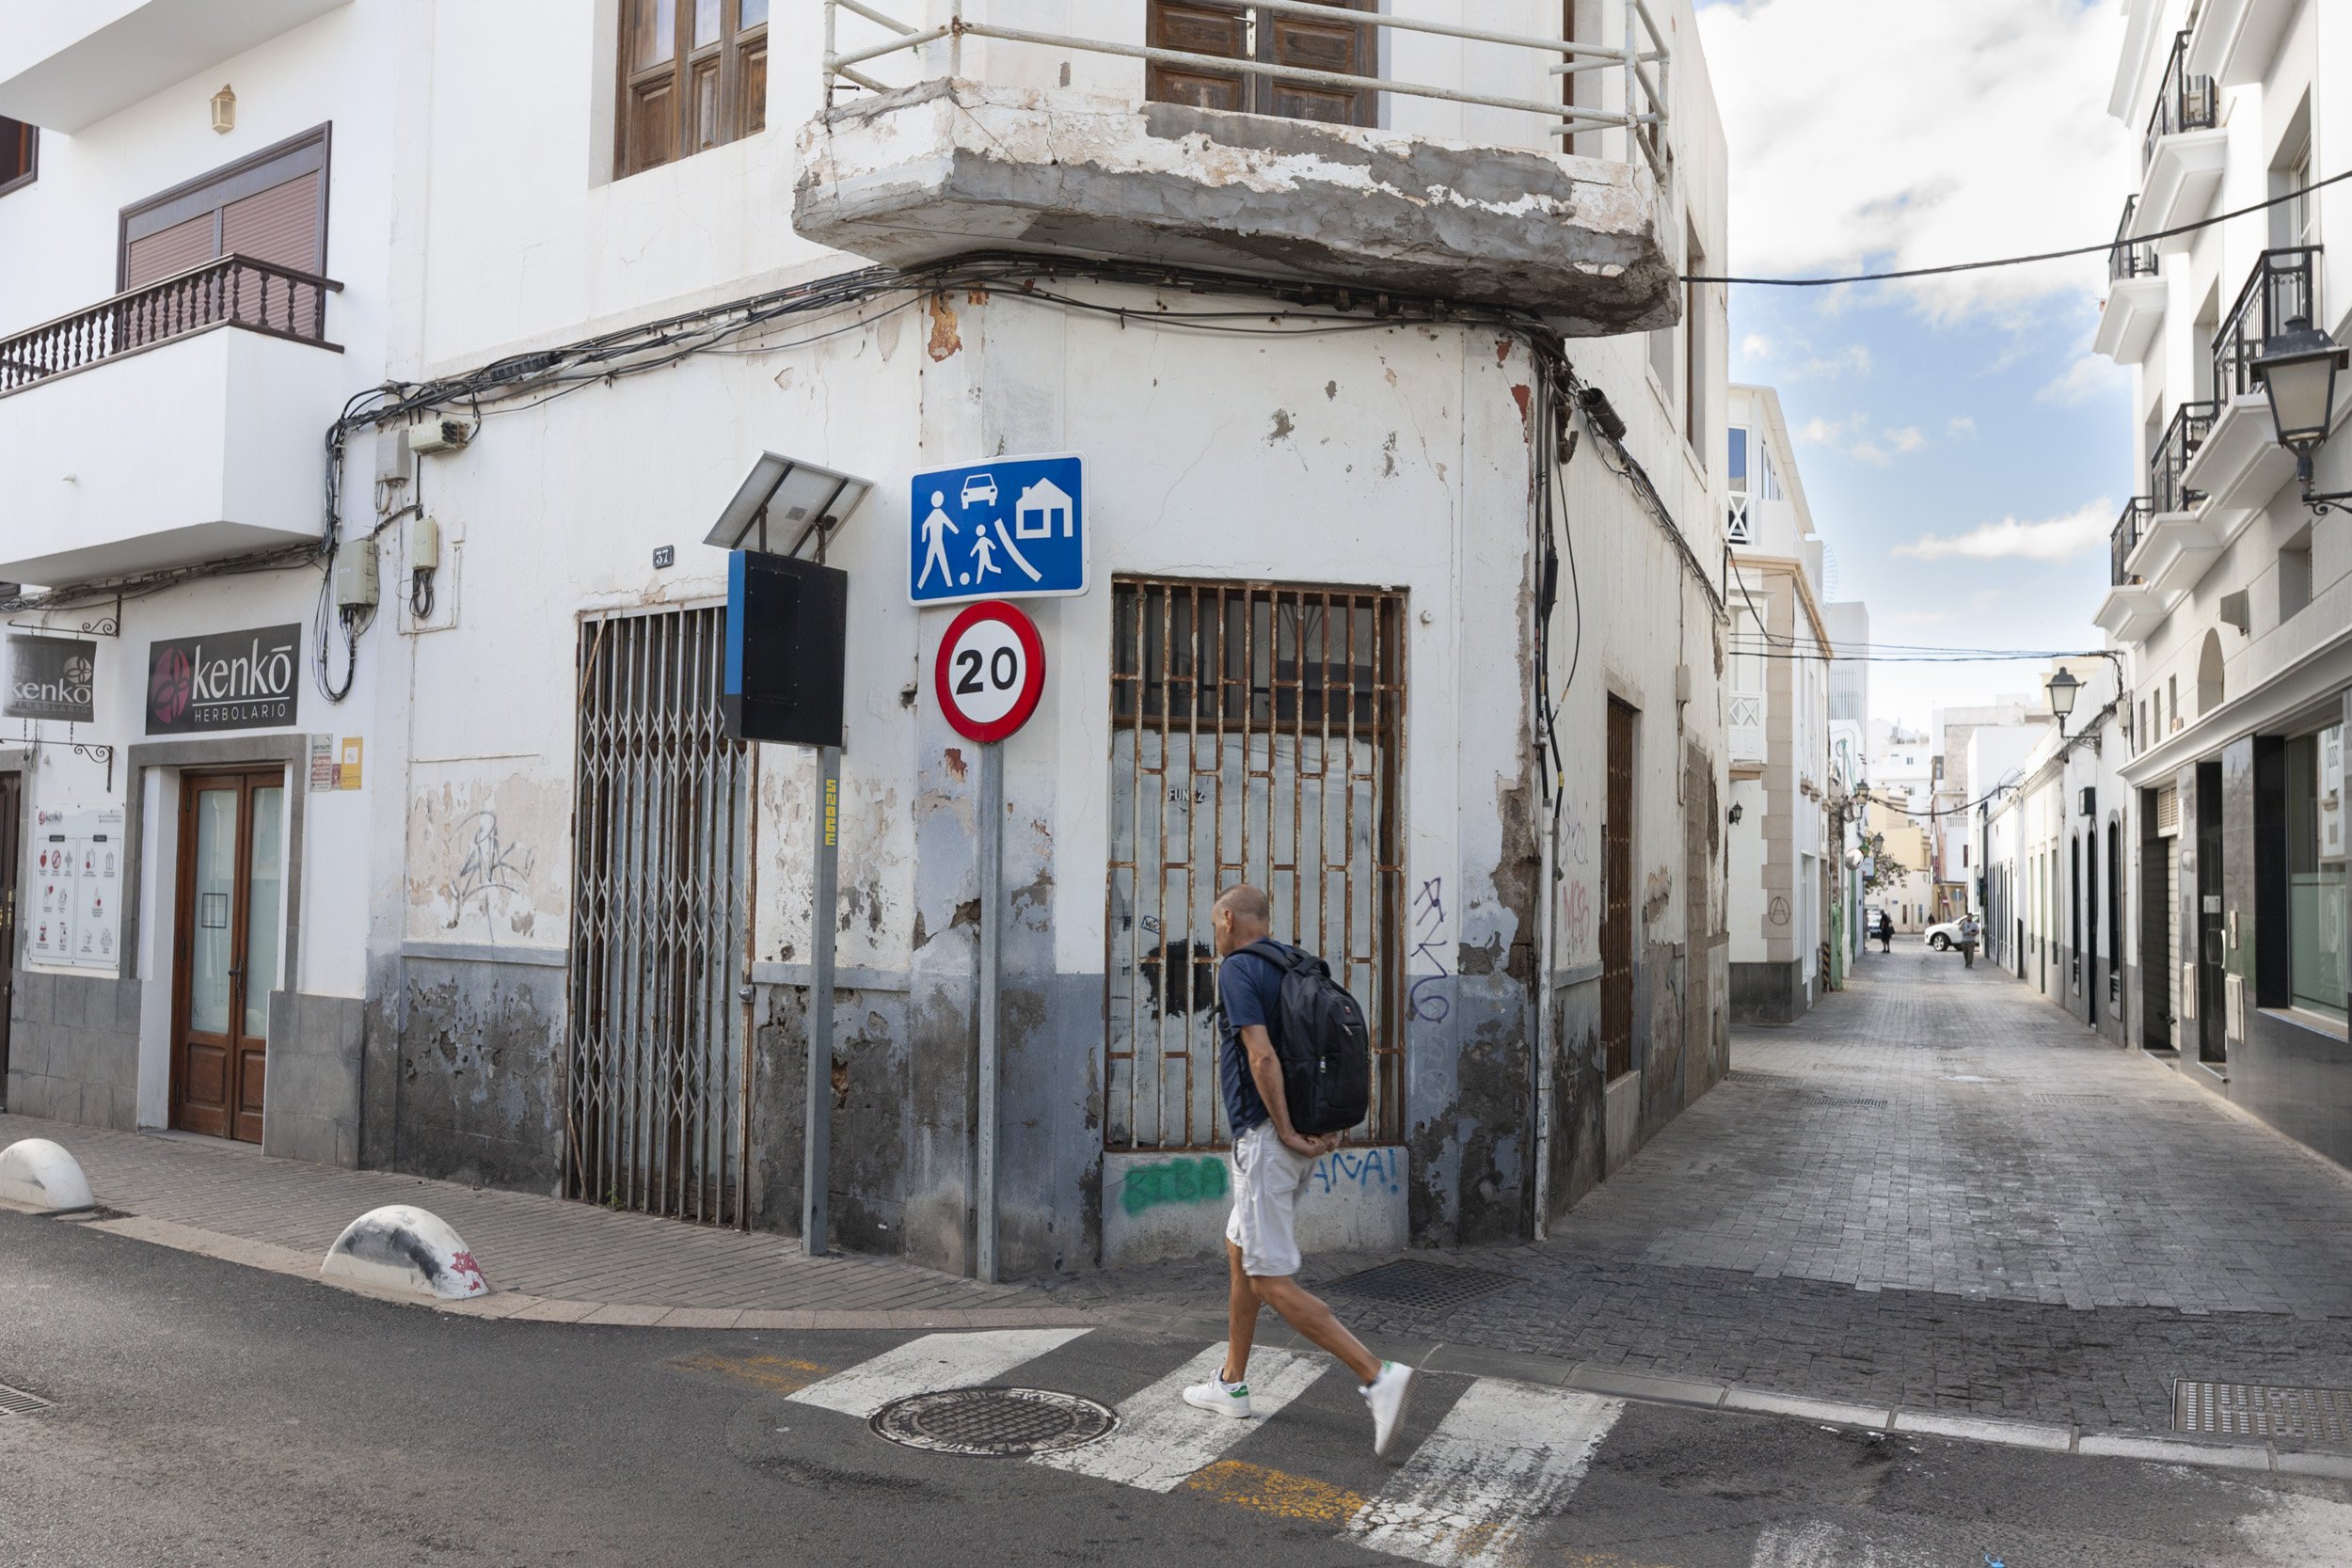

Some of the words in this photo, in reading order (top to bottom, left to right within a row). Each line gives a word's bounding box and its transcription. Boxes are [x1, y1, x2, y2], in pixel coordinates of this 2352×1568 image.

[656, 549, 669, 565] 37
[192, 638, 293, 700] kenkō
[956, 646, 1018, 695] 20
[195, 703, 286, 722] HERBOLARIO
